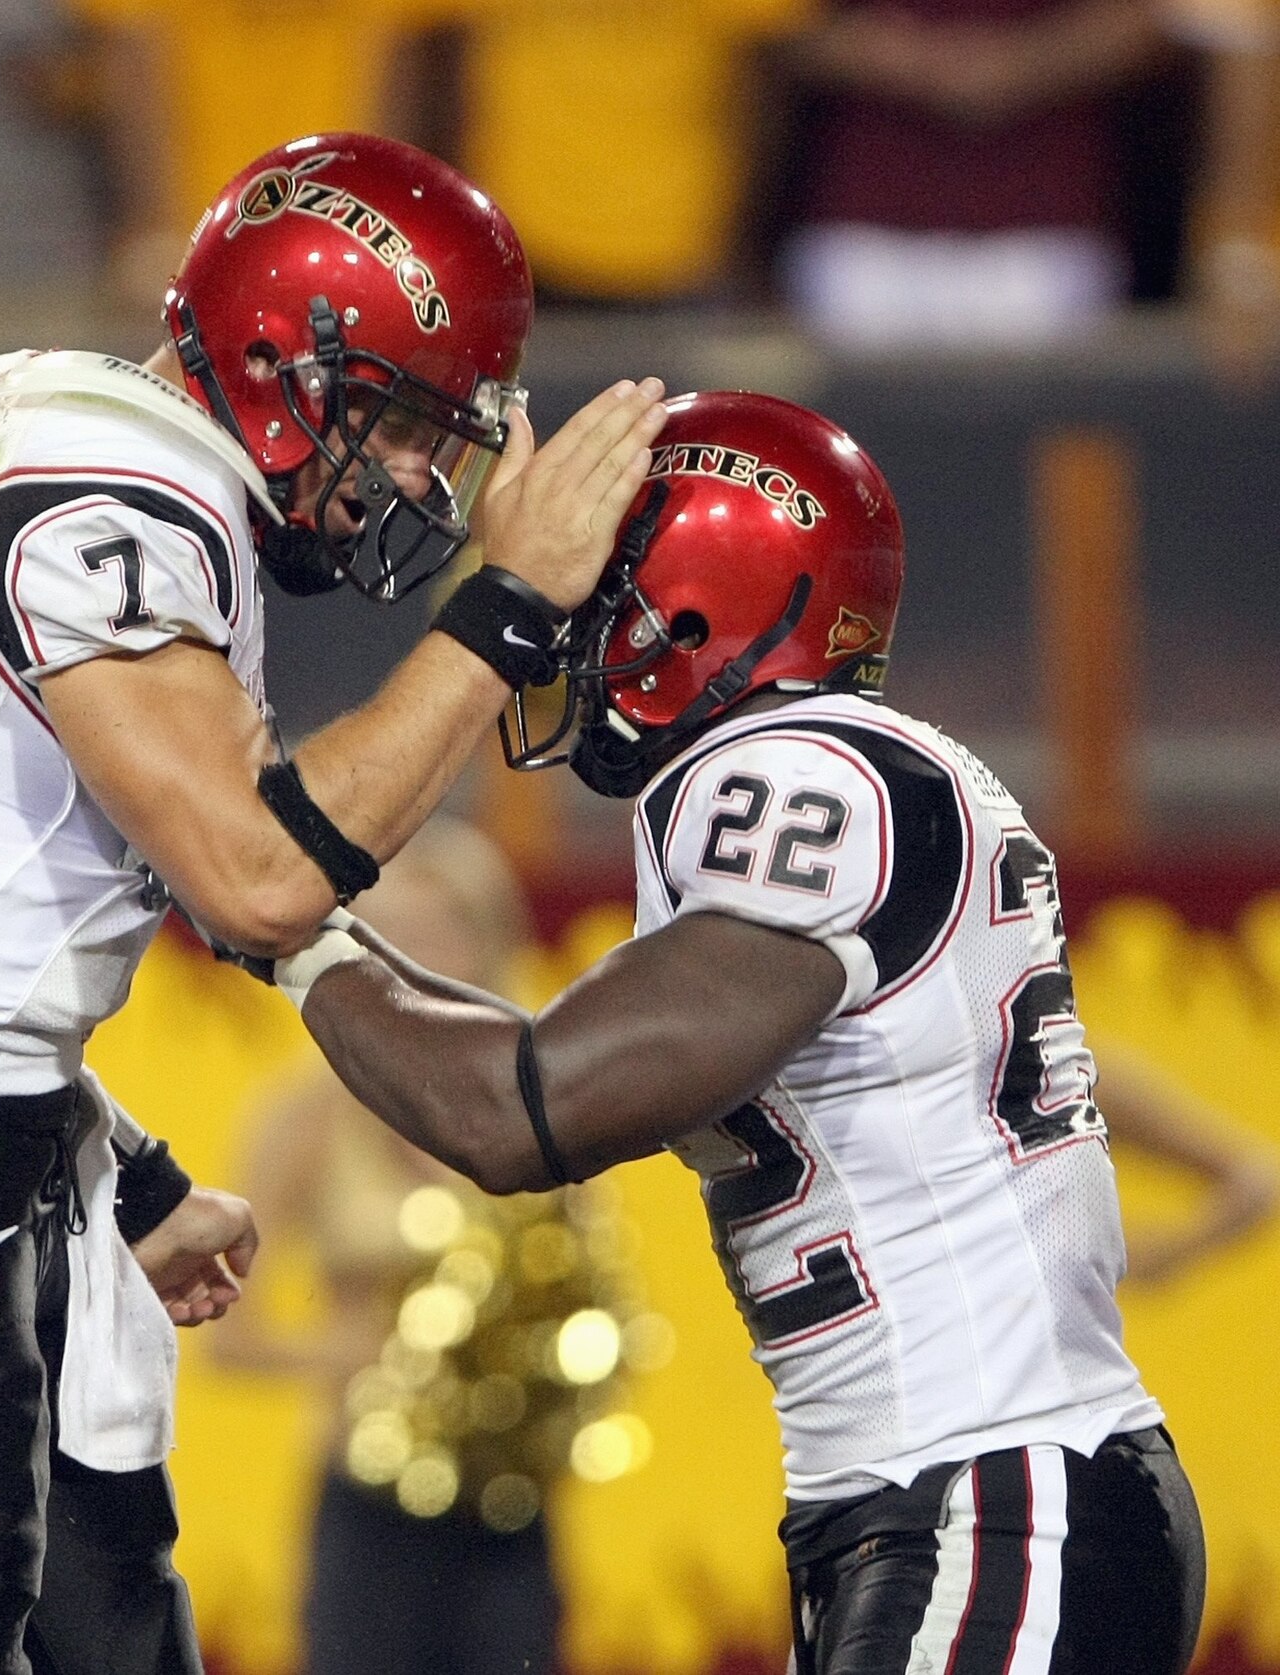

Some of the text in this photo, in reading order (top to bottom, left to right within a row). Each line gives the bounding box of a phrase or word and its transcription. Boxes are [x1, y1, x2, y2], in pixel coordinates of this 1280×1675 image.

[240, 170, 450, 334] AZTECS
[646, 443, 827, 530] ZTECS
[74, 533, 155, 637] 7
[696, 770, 852, 898] 22
